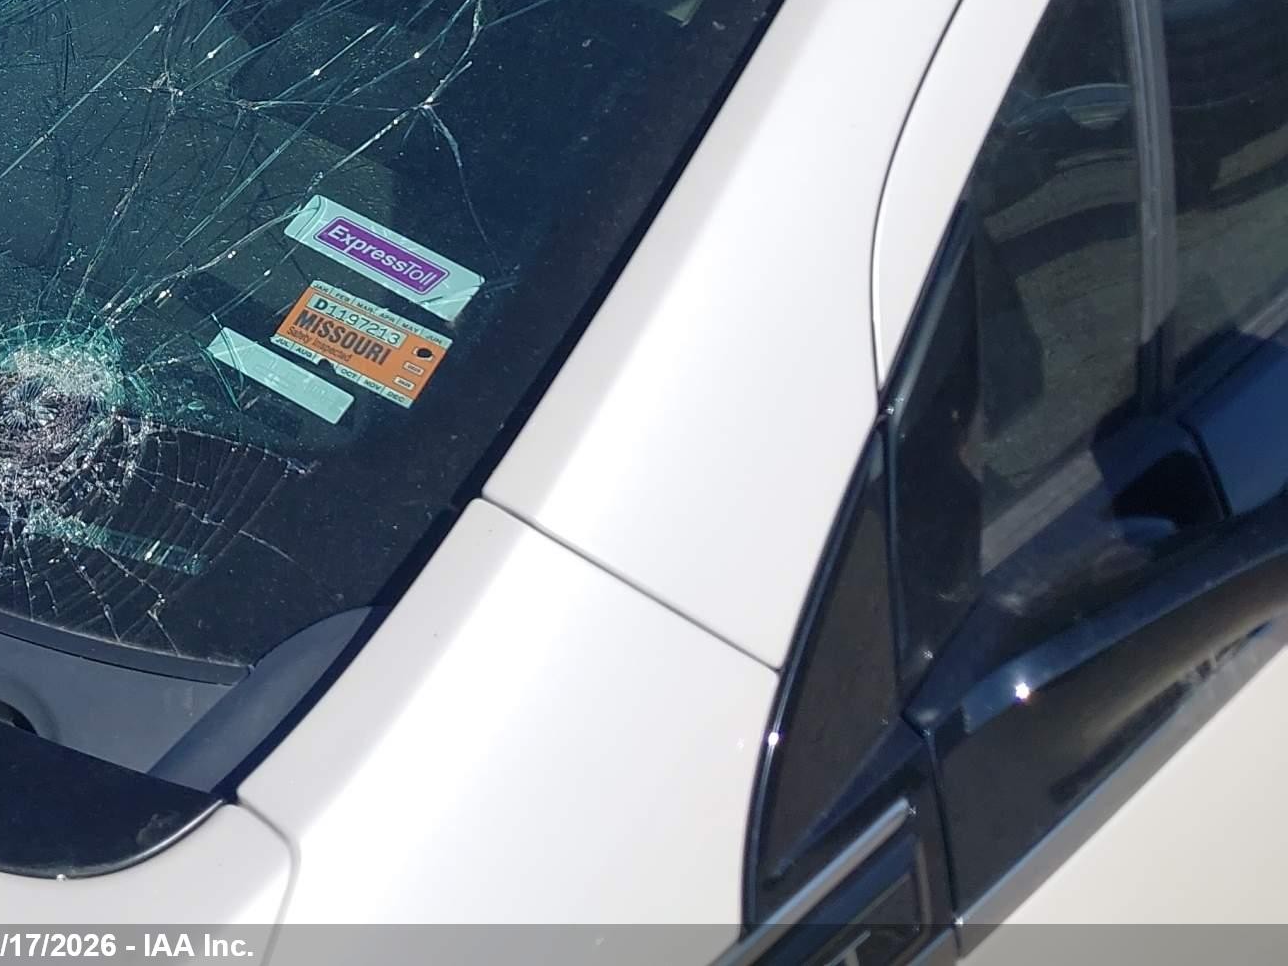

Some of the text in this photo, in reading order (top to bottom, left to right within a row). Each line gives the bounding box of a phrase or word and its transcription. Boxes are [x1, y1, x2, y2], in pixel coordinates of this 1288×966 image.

[327, 224, 437, 286] ExpressToll
[313, 283, 329, 293] JAN
[402, 322, 420, 333] MAY
[313, 297, 402, 346] D1197213
[293, 309, 392, 366] MISSOURI
[275, 337, 405, 402] JUL AUG OCT NOV DEC
